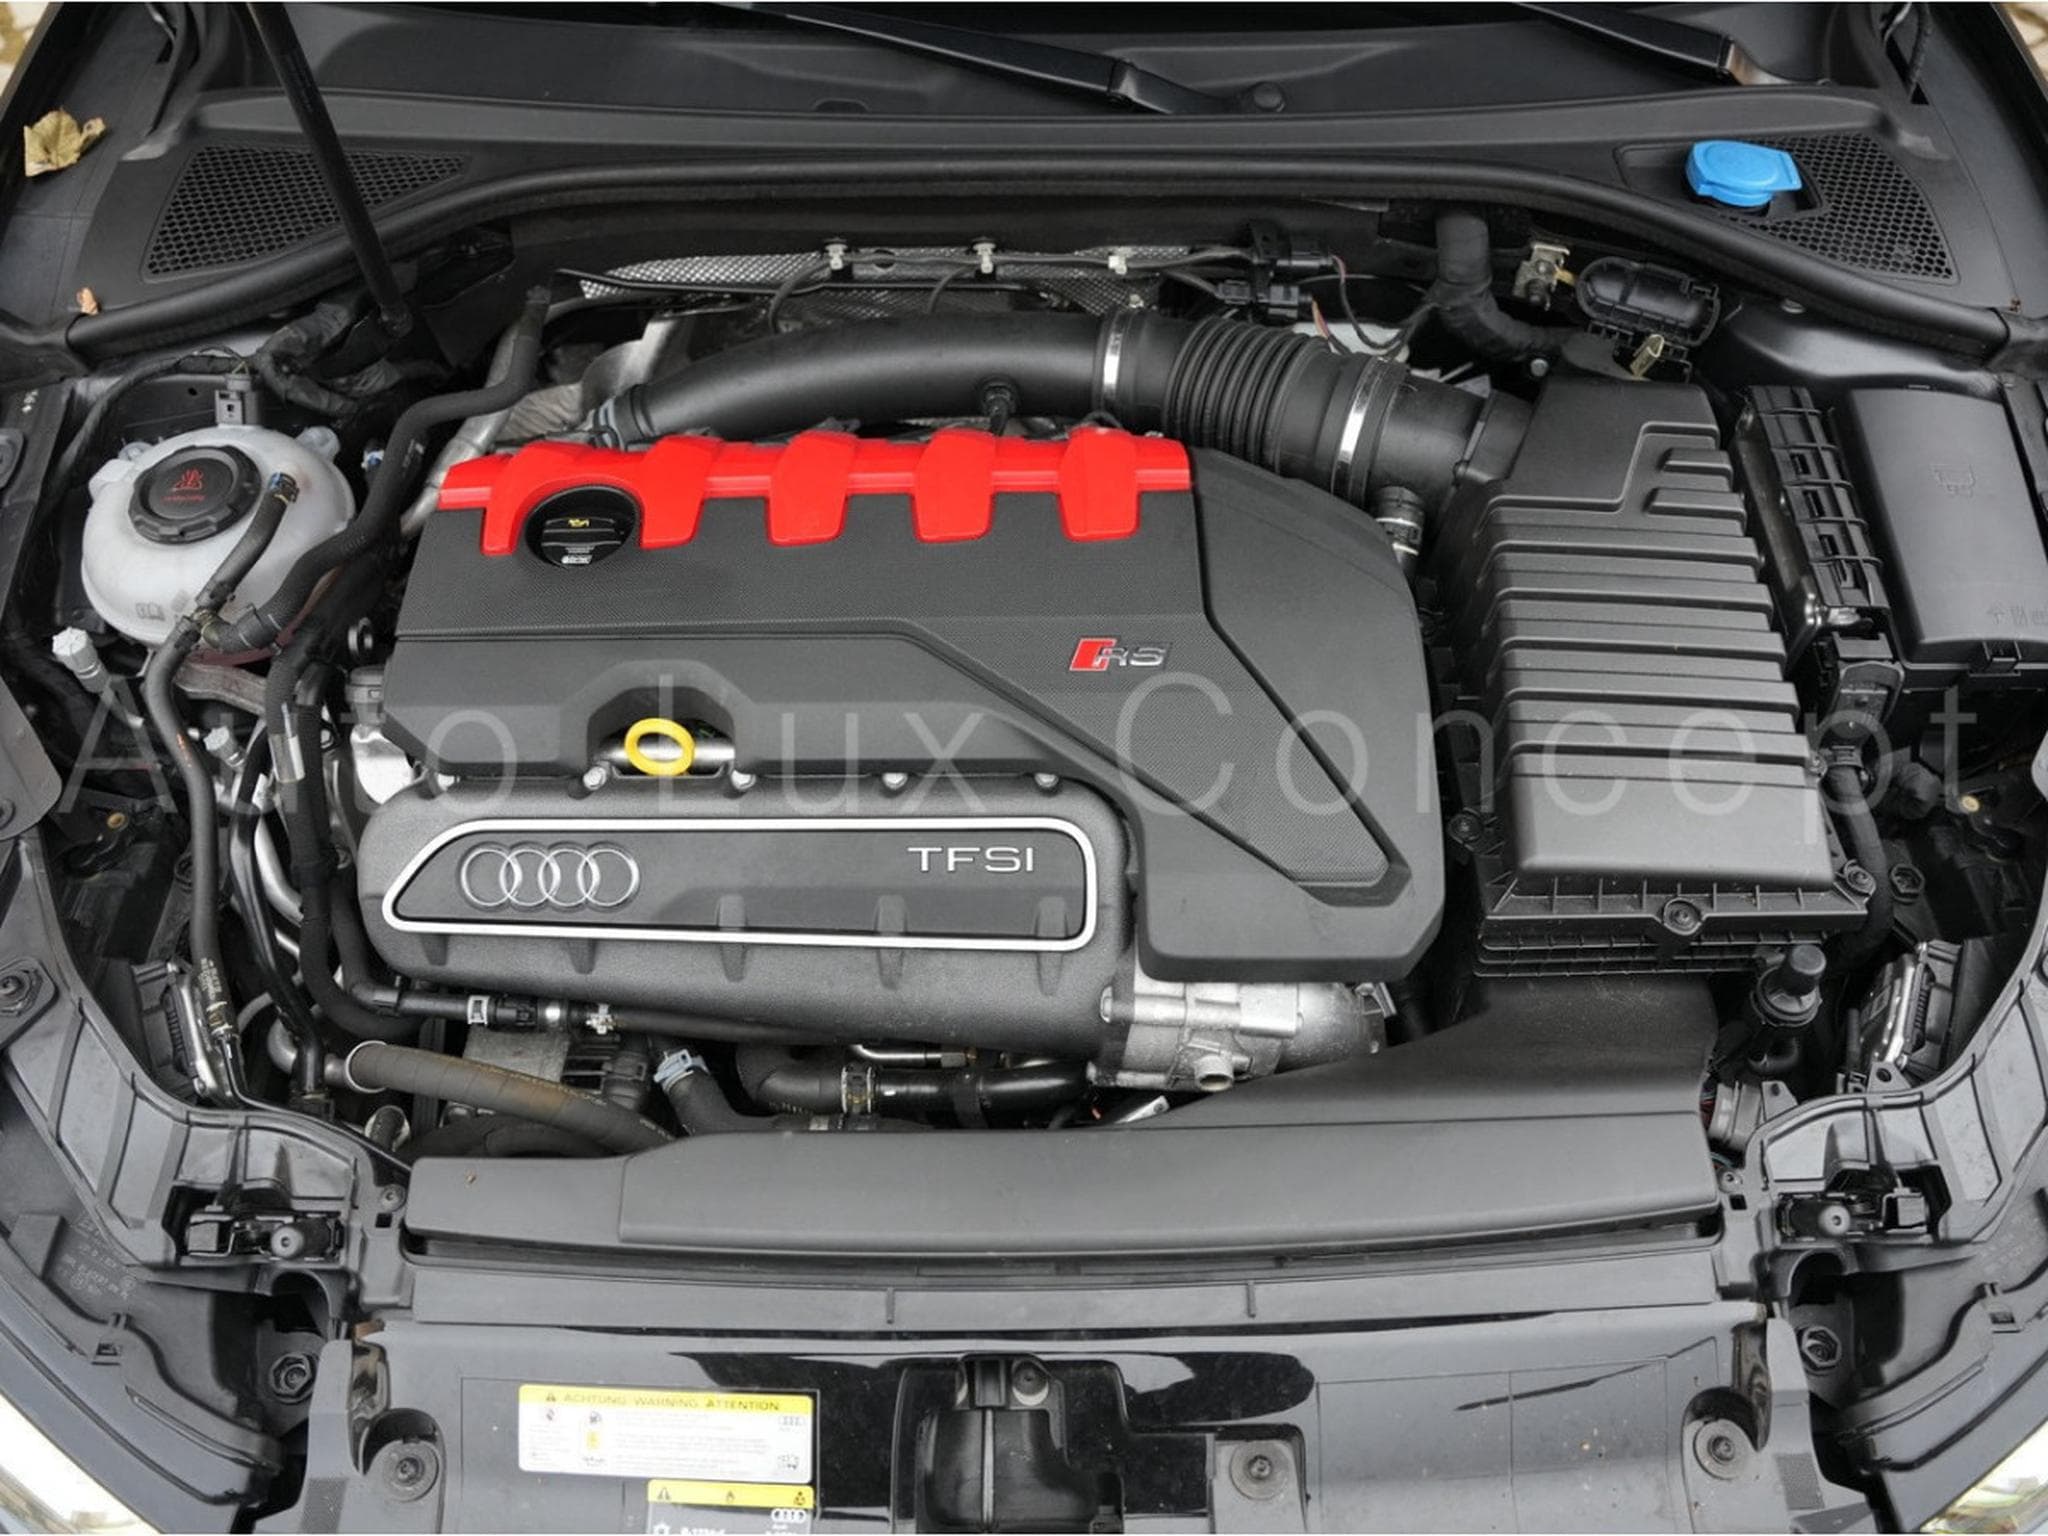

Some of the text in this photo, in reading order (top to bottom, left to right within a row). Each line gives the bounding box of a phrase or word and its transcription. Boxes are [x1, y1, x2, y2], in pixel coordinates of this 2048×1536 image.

[1090, 645, 1167, 668] RS
[907, 846, 1034, 872] TFSI
[563, 1392, 780, 1411] ACHTUNG WARNING ATTENTION
